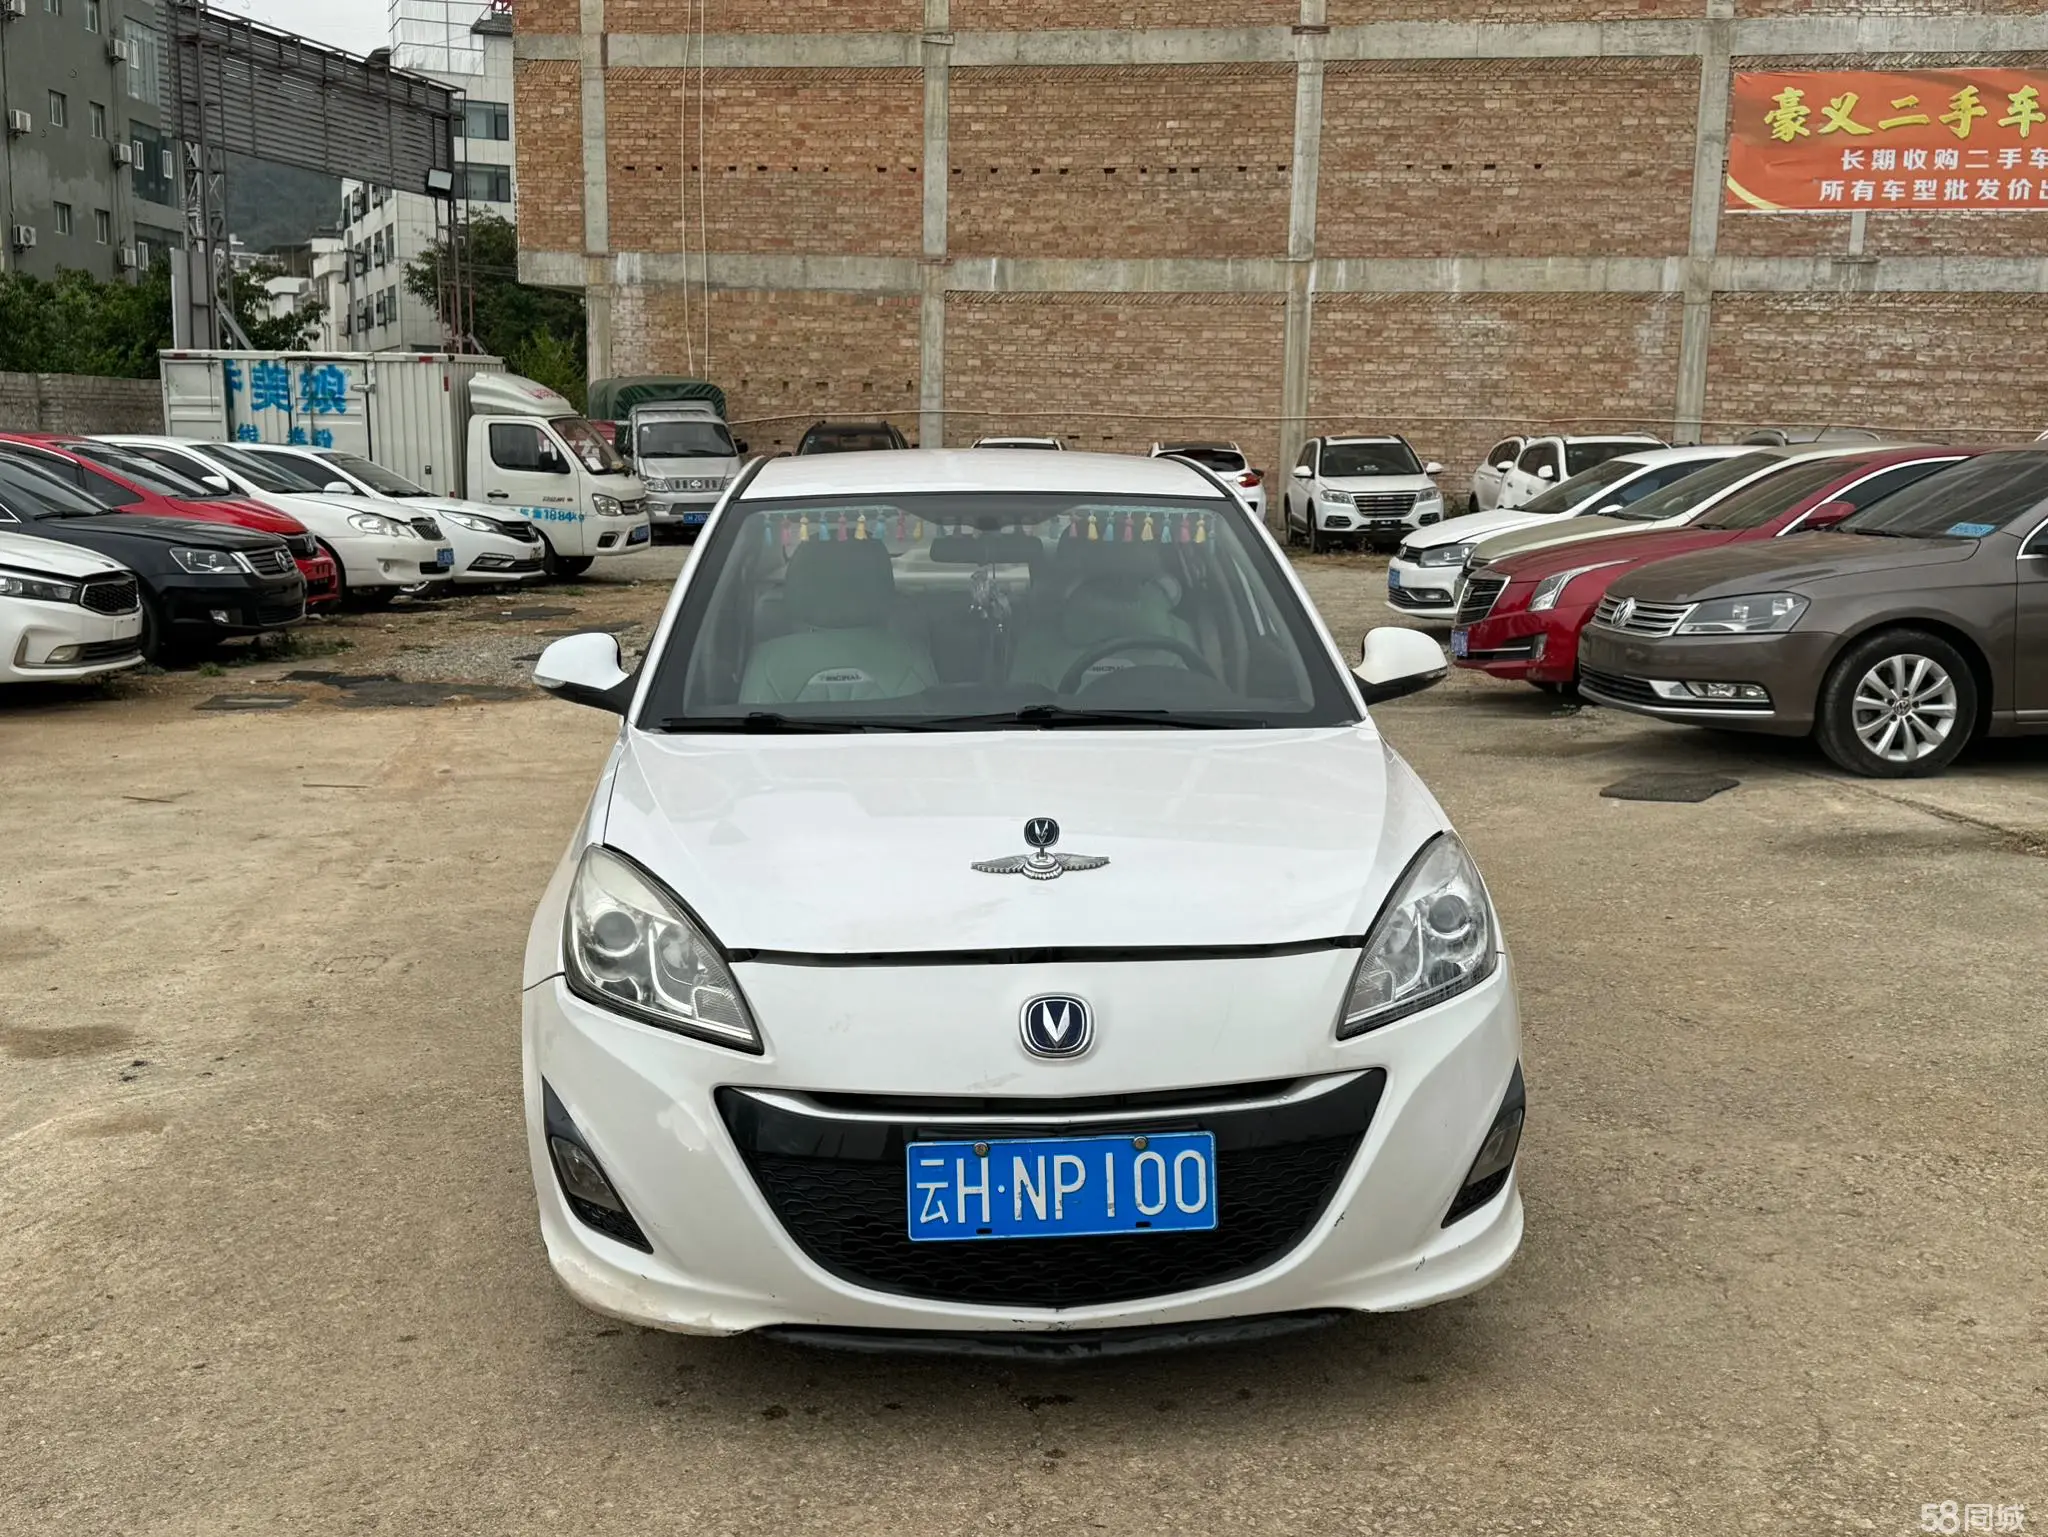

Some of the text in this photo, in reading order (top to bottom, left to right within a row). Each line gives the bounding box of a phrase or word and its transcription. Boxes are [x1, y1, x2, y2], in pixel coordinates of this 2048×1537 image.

[1764, 85, 2046, 142] 豪义二手车
[1841, 148, 2048, 171] 长期收购二手车
